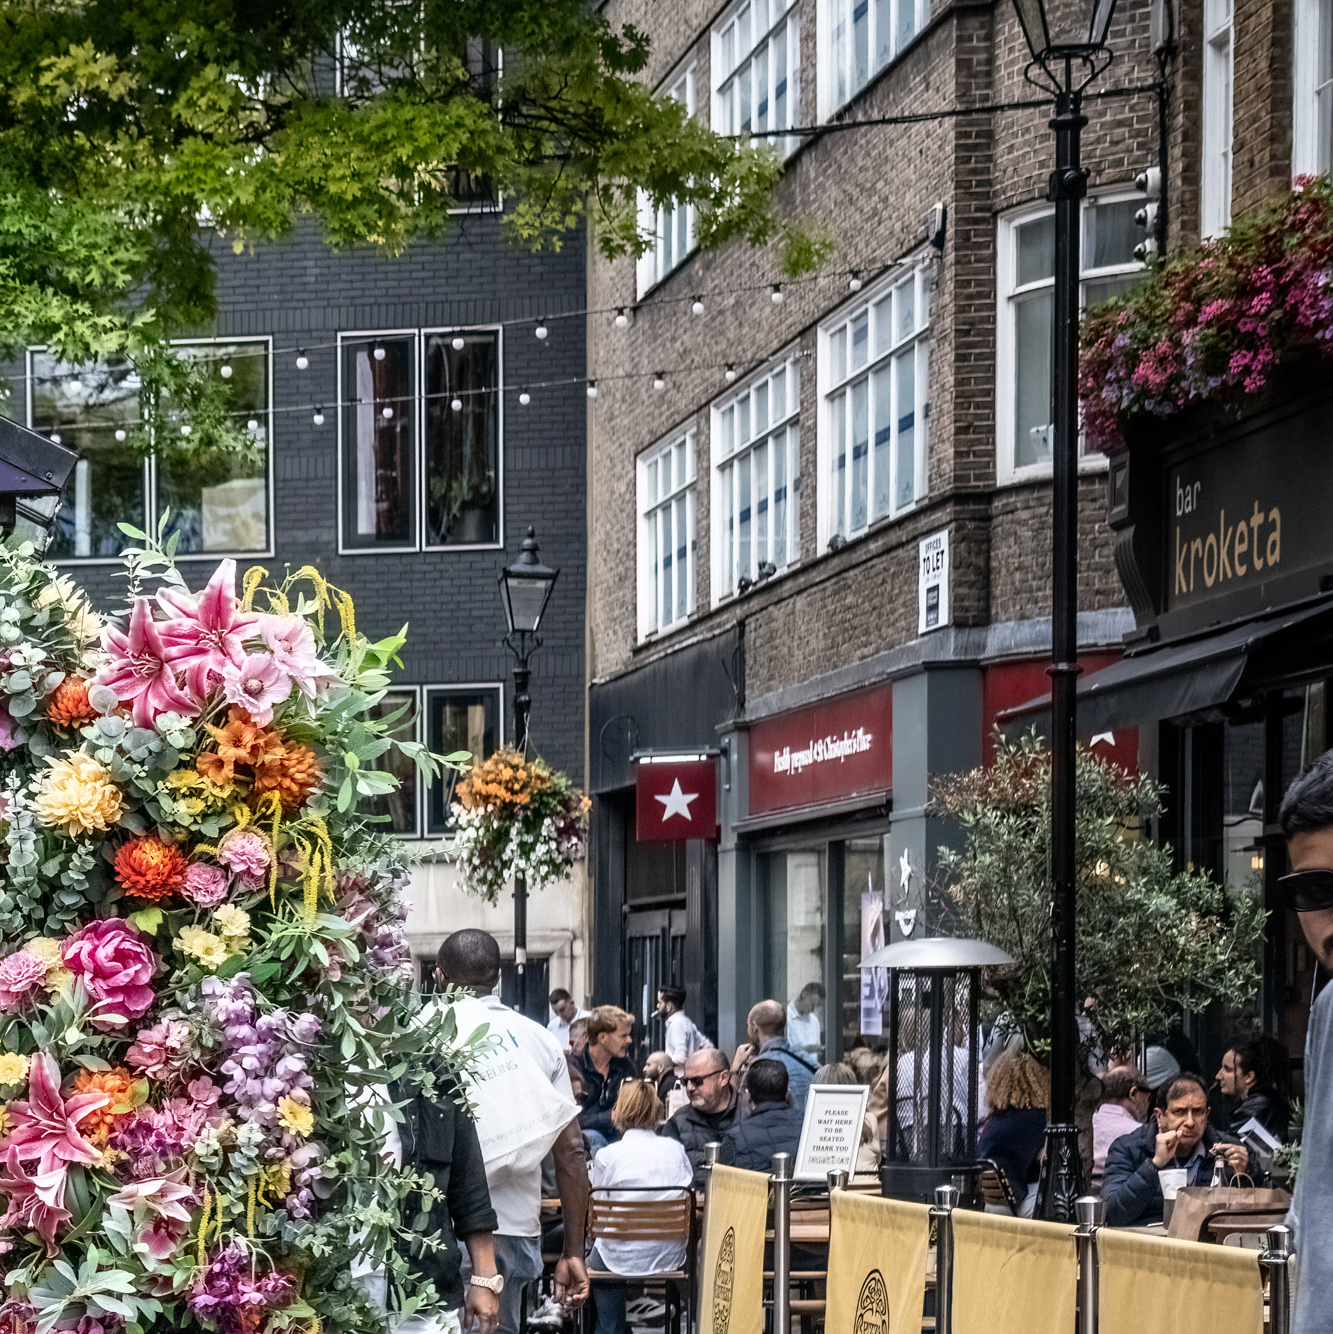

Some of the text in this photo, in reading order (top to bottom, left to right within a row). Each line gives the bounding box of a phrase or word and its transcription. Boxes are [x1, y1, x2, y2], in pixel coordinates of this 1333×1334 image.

[1176, 476, 1201, 517] bar
[923, 549, 945, 576] TO LET
[925, 537, 942, 554] OFFICES
[1175, 500, 1281, 596] kroketa
